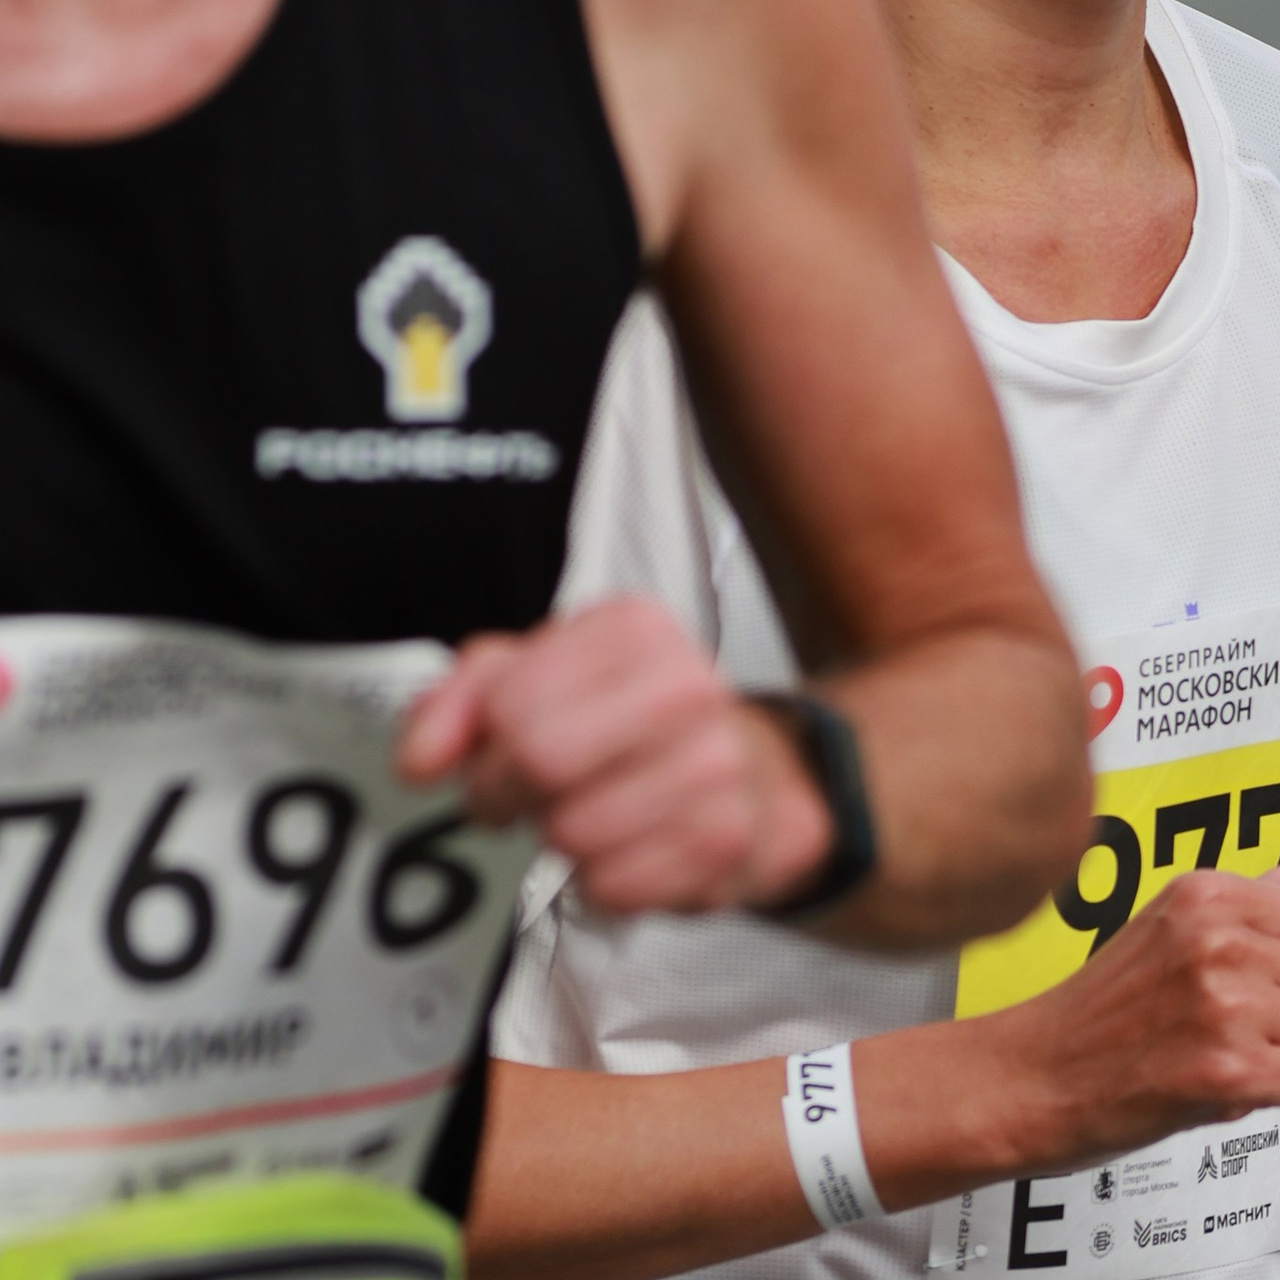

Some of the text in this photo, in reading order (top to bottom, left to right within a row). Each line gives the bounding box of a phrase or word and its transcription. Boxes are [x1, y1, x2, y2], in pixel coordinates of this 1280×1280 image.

[1139, 638, 1257, 677] СБЕРПРАЙМ
[1136, 697, 1253, 742] МАРАФОН
[0, 773, 481, 993] 7696
[801, 1050, 838, 1123] 977
[1221, 1124, 1279, 1159] МОСКОВСКИЙ
[1221, 1155, 1249, 1179] СПОРТ
[1151, 1227, 1188, 1247] BRICS
